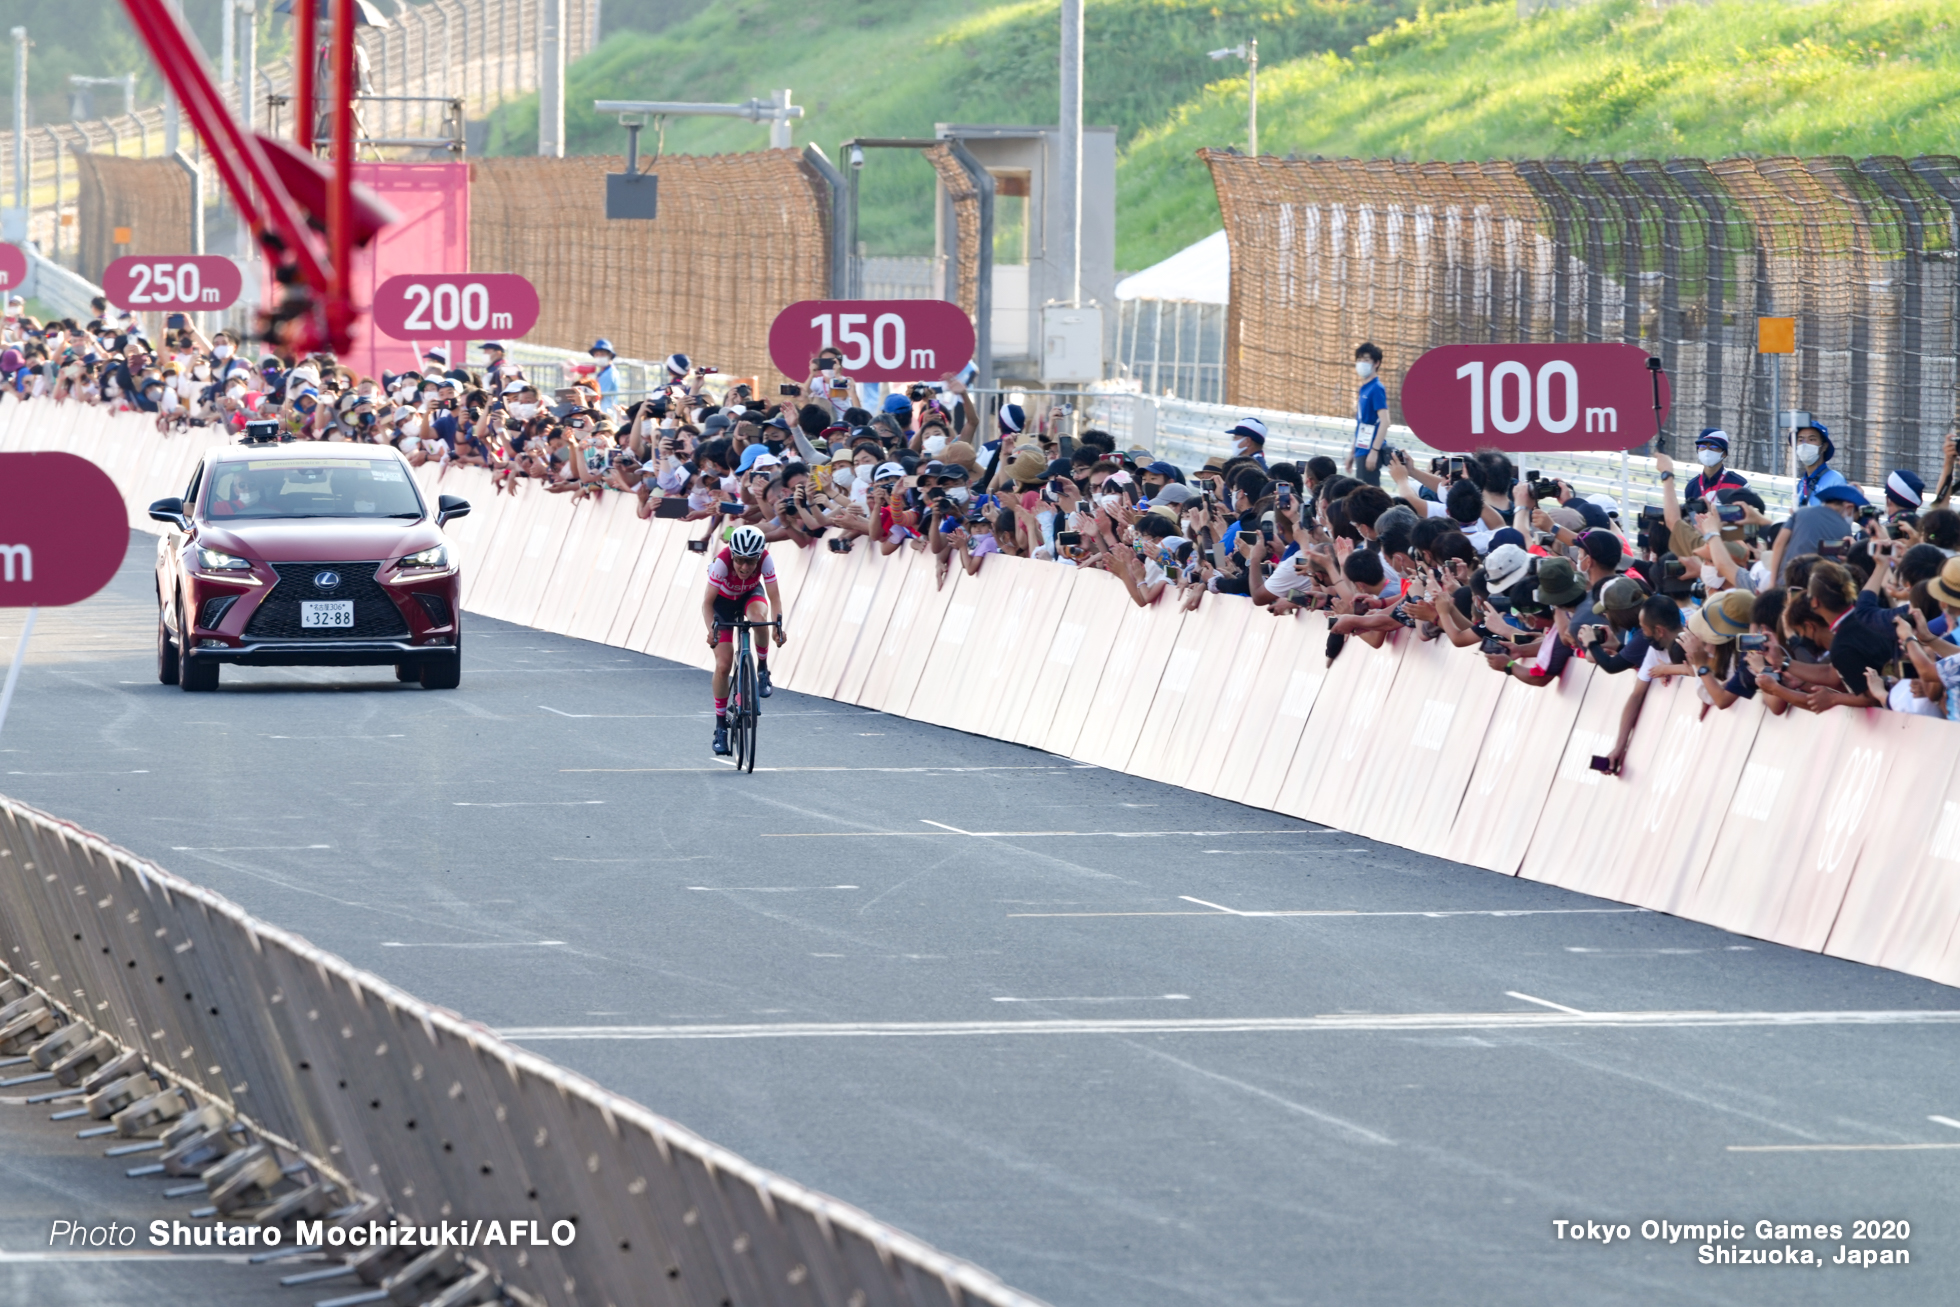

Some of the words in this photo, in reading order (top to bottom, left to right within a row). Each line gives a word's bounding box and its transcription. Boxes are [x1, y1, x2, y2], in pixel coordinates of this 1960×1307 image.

[127, 262, 220, 304] 250m
[403, 283, 513, 331] 200m
[810, 312, 936, 370] 150m
[1456, 359, 1617, 434] 100m
[313, 611, 350, 625] 32-88
